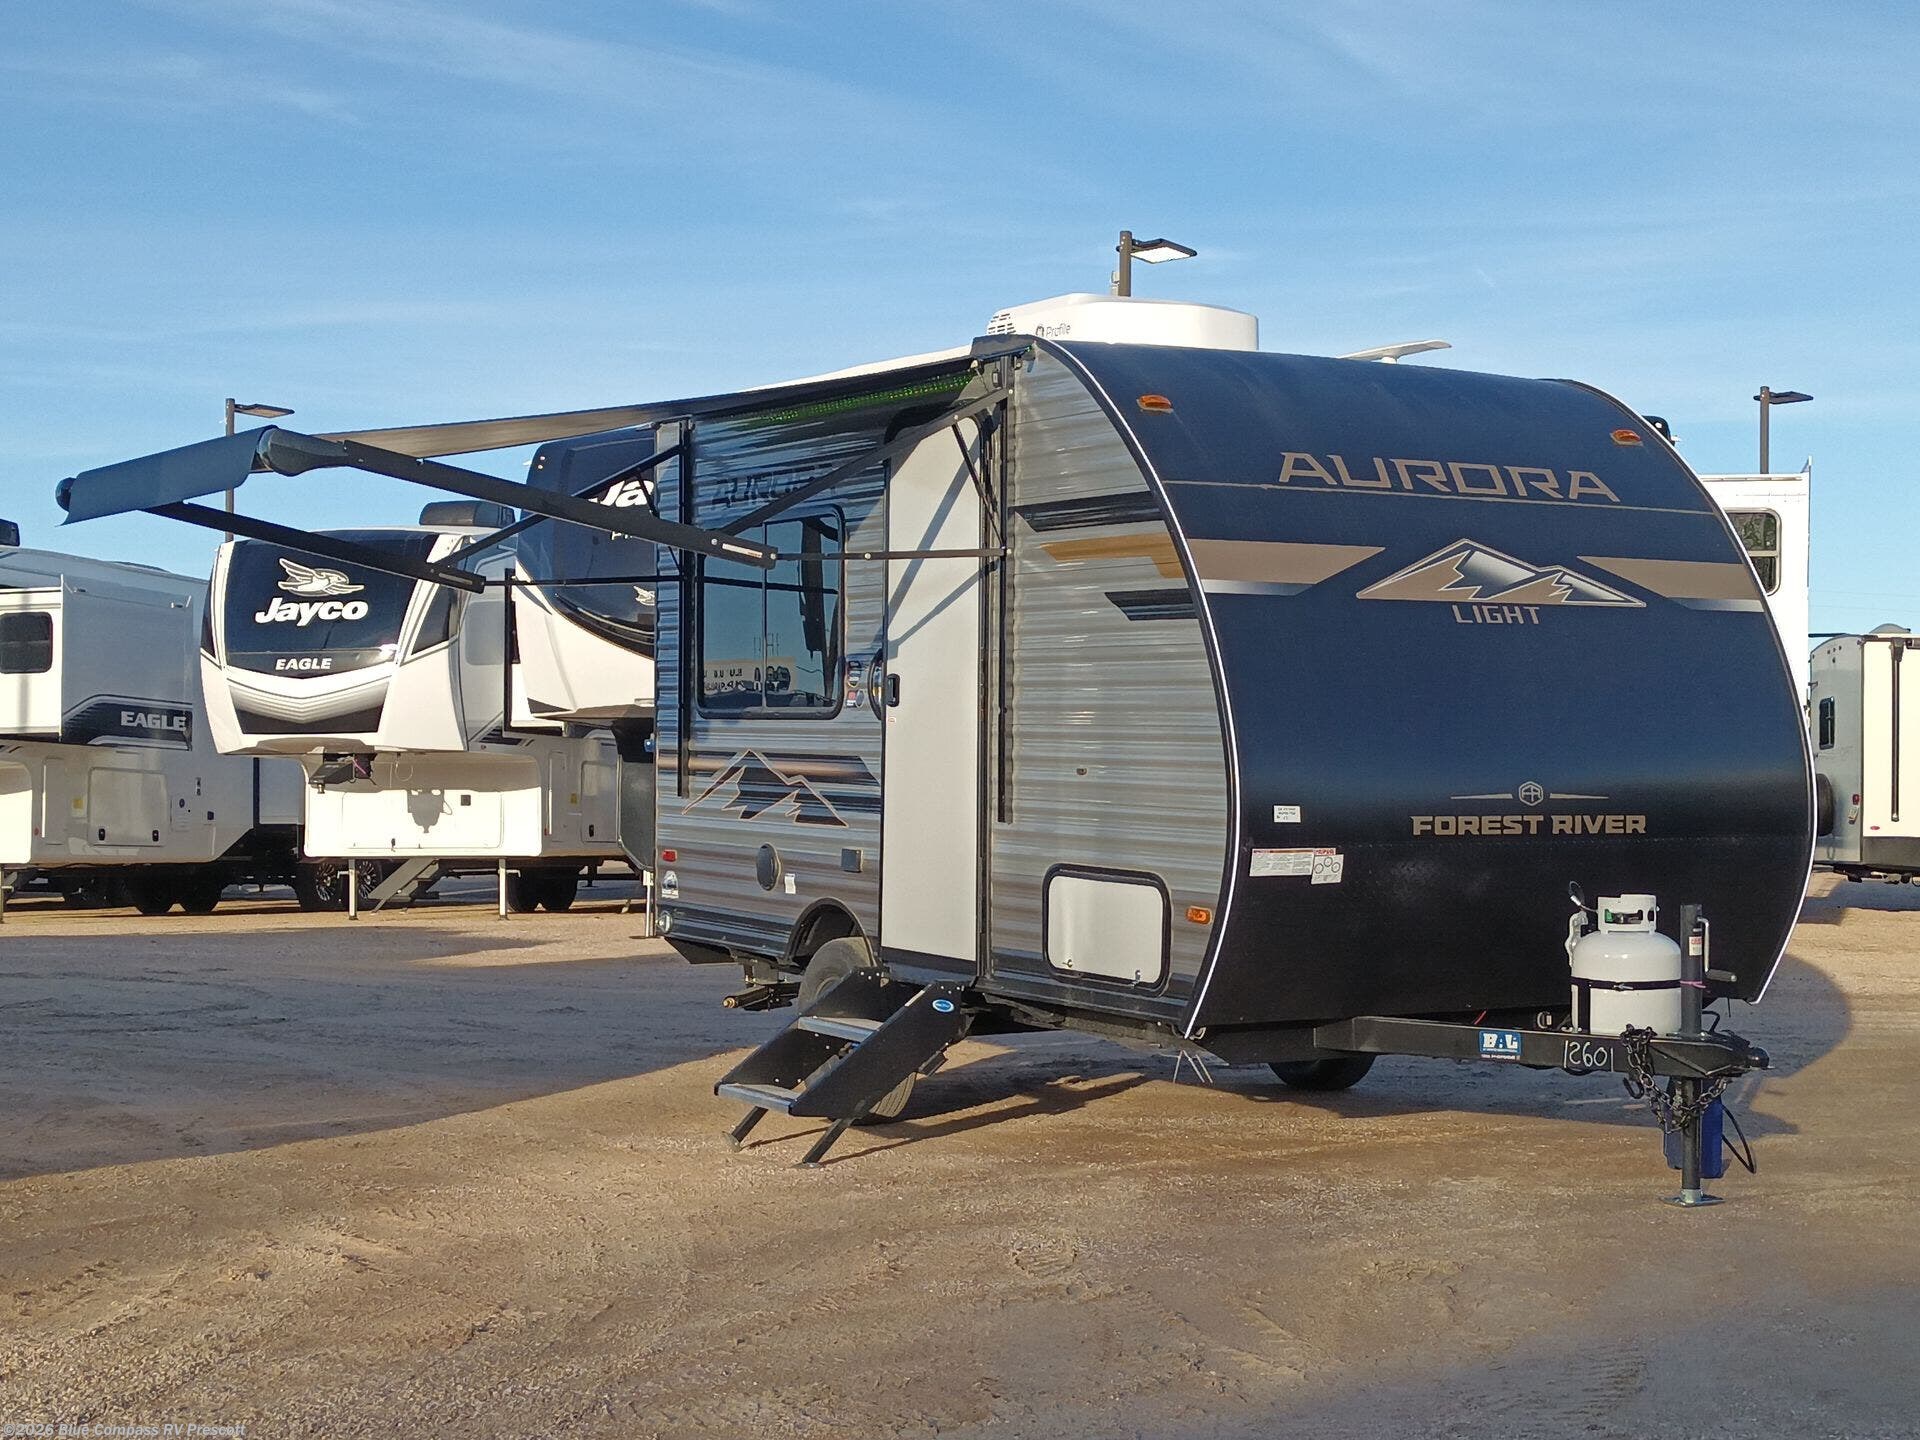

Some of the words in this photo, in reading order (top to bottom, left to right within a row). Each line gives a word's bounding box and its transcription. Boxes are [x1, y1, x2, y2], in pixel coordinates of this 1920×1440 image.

[1278, 451, 1621, 503] AURORA
[255, 598, 369, 627] Jayco
[1452, 605, 1540, 625] LIGHT
[275, 657, 332, 670] EAGLE
[120, 710, 187, 732] EAGLE
[1411, 815, 1544, 836] FOREST
[1551, 814, 1647, 835] RIVER
